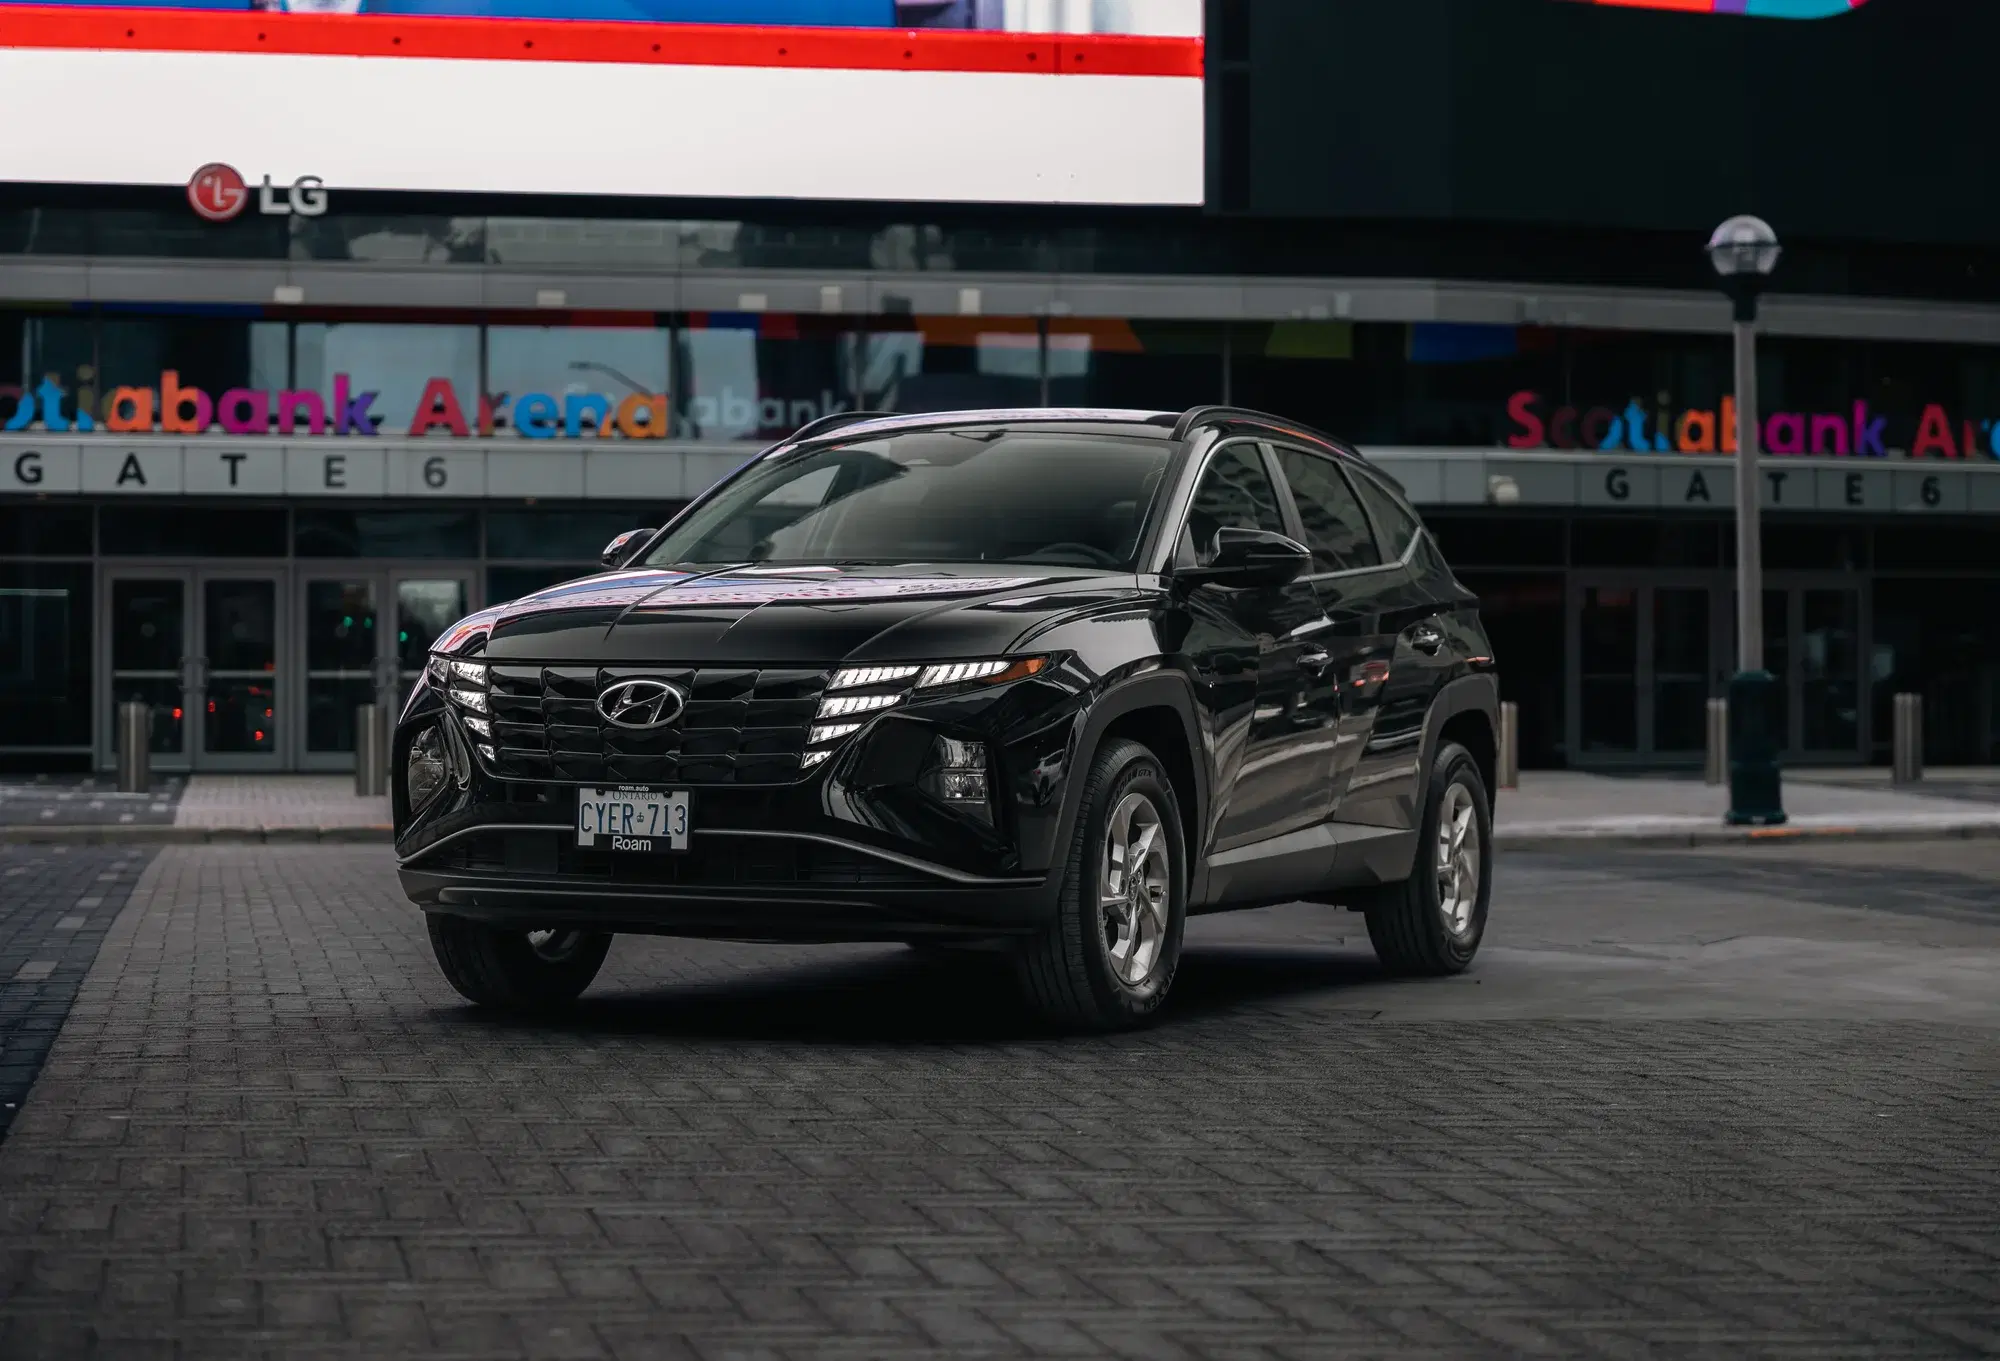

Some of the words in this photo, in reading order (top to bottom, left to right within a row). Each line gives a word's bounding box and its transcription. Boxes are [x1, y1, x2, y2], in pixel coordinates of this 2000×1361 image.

[259, 173, 328, 216] LG
[408, 377, 668, 439] Arena
[1911, 402, 2000, 461] Ar
[423, 456, 447, 489] 6
[1921, 475, 1942, 506] 6
[612, 792, 658, 800] ONTARIO
[580, 802, 634, 834] CYER
[648, 803, 687, 835] 713
[612, 835, 652, 851] Roam
